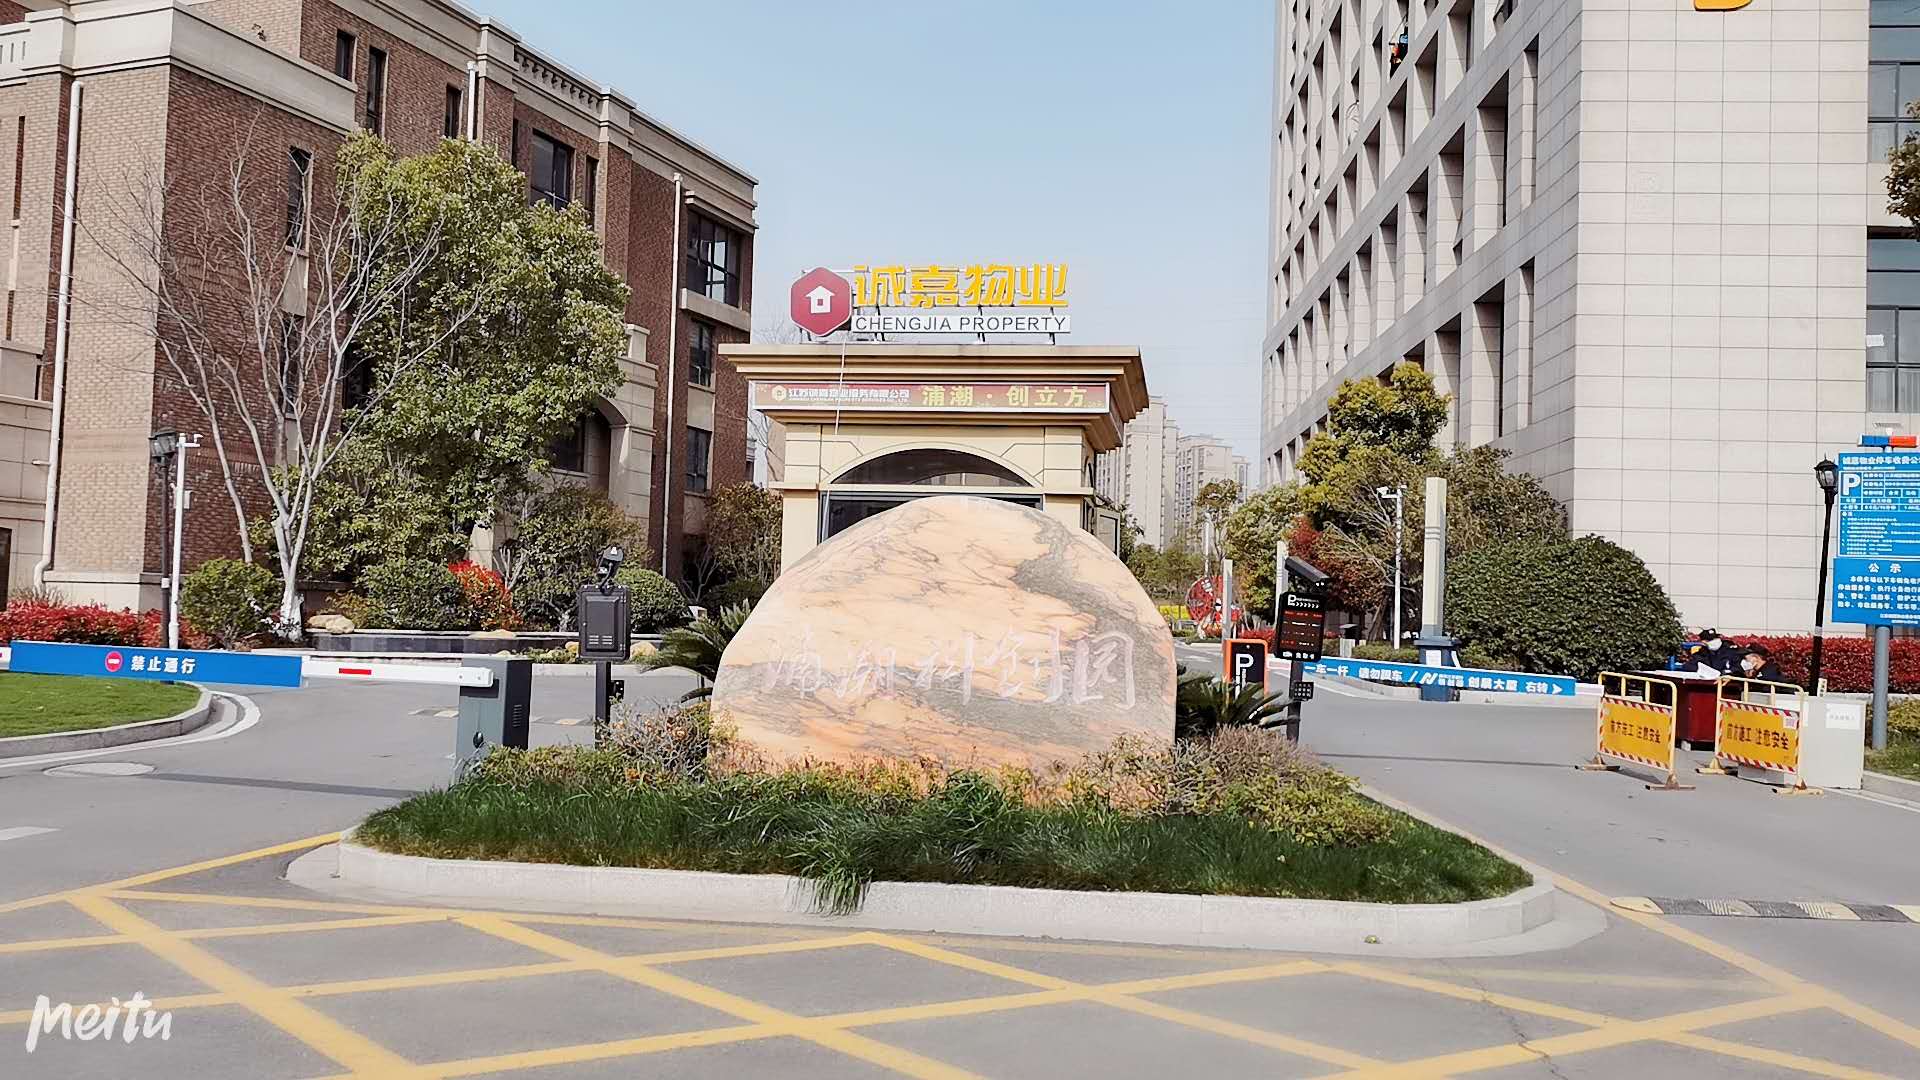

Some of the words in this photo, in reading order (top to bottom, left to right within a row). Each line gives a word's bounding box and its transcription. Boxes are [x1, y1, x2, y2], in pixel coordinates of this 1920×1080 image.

[853, 264, 1069, 309] 诚嘉物业
[855, 316, 952, 331] CHENGJIA
[959, 316, 1066, 331] PROPERTY
[1842, 473, 1861, 496] P
[130, 655, 196, 674] 禁止通行
